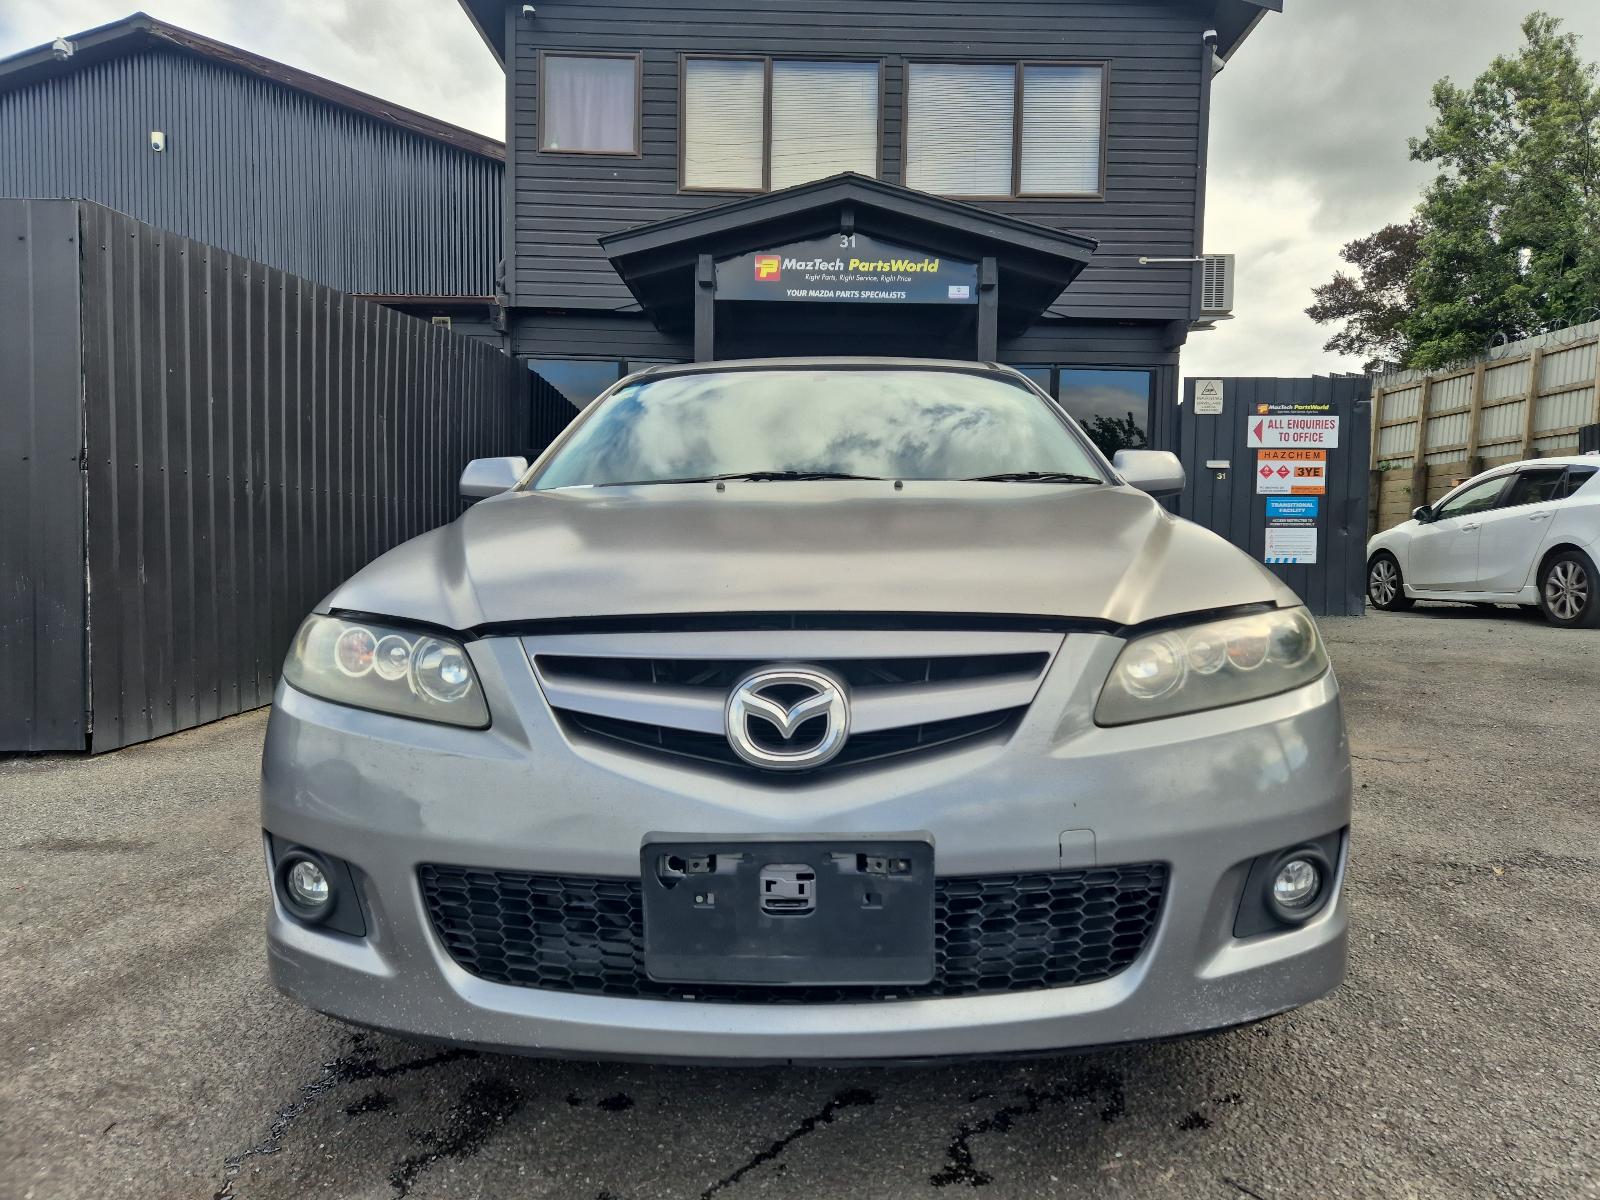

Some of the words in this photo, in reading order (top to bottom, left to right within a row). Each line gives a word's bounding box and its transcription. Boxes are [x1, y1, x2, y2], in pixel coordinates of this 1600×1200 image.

[839, 234, 856, 248] 31
[782, 258, 844, 271] MazTech
[848, 258, 940, 273] PartsWorld
[805, 273, 821, 282] Right
[839, 274, 855, 282] Right
[880, 275, 896, 283] Right
[786, 289, 808, 297] YOUR
[808, 289, 835, 298] MAZDA
[835, 290, 859, 298] PARTS
[860, 290, 906, 299] SPECIALISTS
[1267, 419, 1284, 429] ALL
[1287, 419, 1336, 429] ENQUIRIES
[1279, 432, 1290, 442] TO
[1293, 432, 1324, 442] OFFICE
[1264, 451, 1321, 459] HAZCHEM
[1216, 472, 1226, 480] 31
[1297, 467, 1320, 477] 3YE
